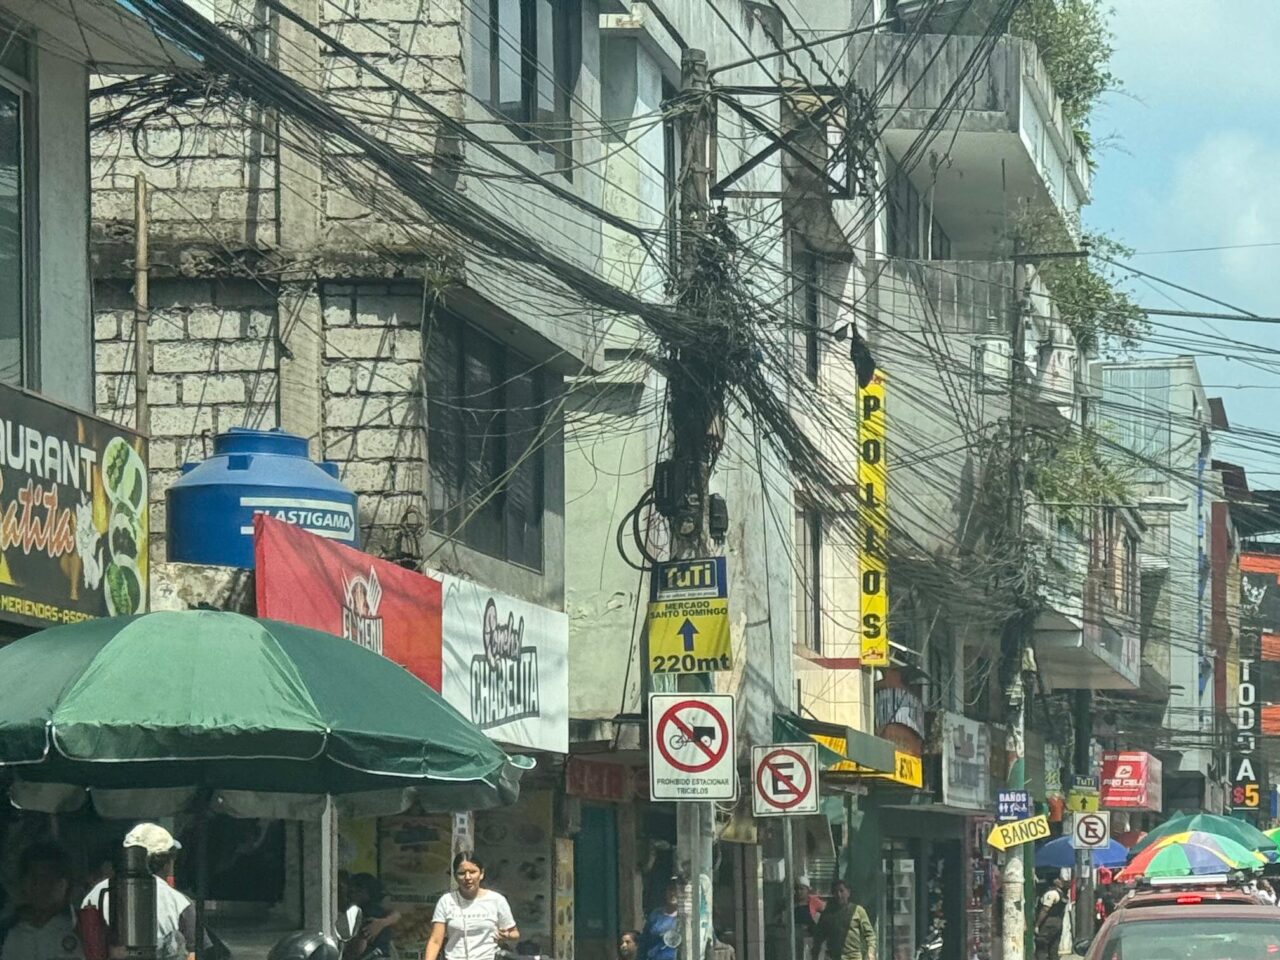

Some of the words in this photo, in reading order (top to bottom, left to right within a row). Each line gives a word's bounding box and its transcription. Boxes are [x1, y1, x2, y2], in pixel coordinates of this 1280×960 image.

[0, 478, 75, 558] atita
[254, 510, 351, 529] ASTIGAMA
[862, 395, 881, 639] POLLOS
[650, 610, 680, 619] SANTO
[682, 607, 728, 617] DOMINGO
[664, 601, 710, 610] MERCADO
[652, 653, 730, 674] 220mt
[471, 651, 540, 727] CHABELITA
[657, 778, 691, 786] PROHIBIDO
[692, 778, 730, 786] ESTACIONAR
[999, 791, 1027, 803] BAÑOS
[1232, 783, 1260, 807] $5
[1000, 818, 1047, 846] BAÑOS
